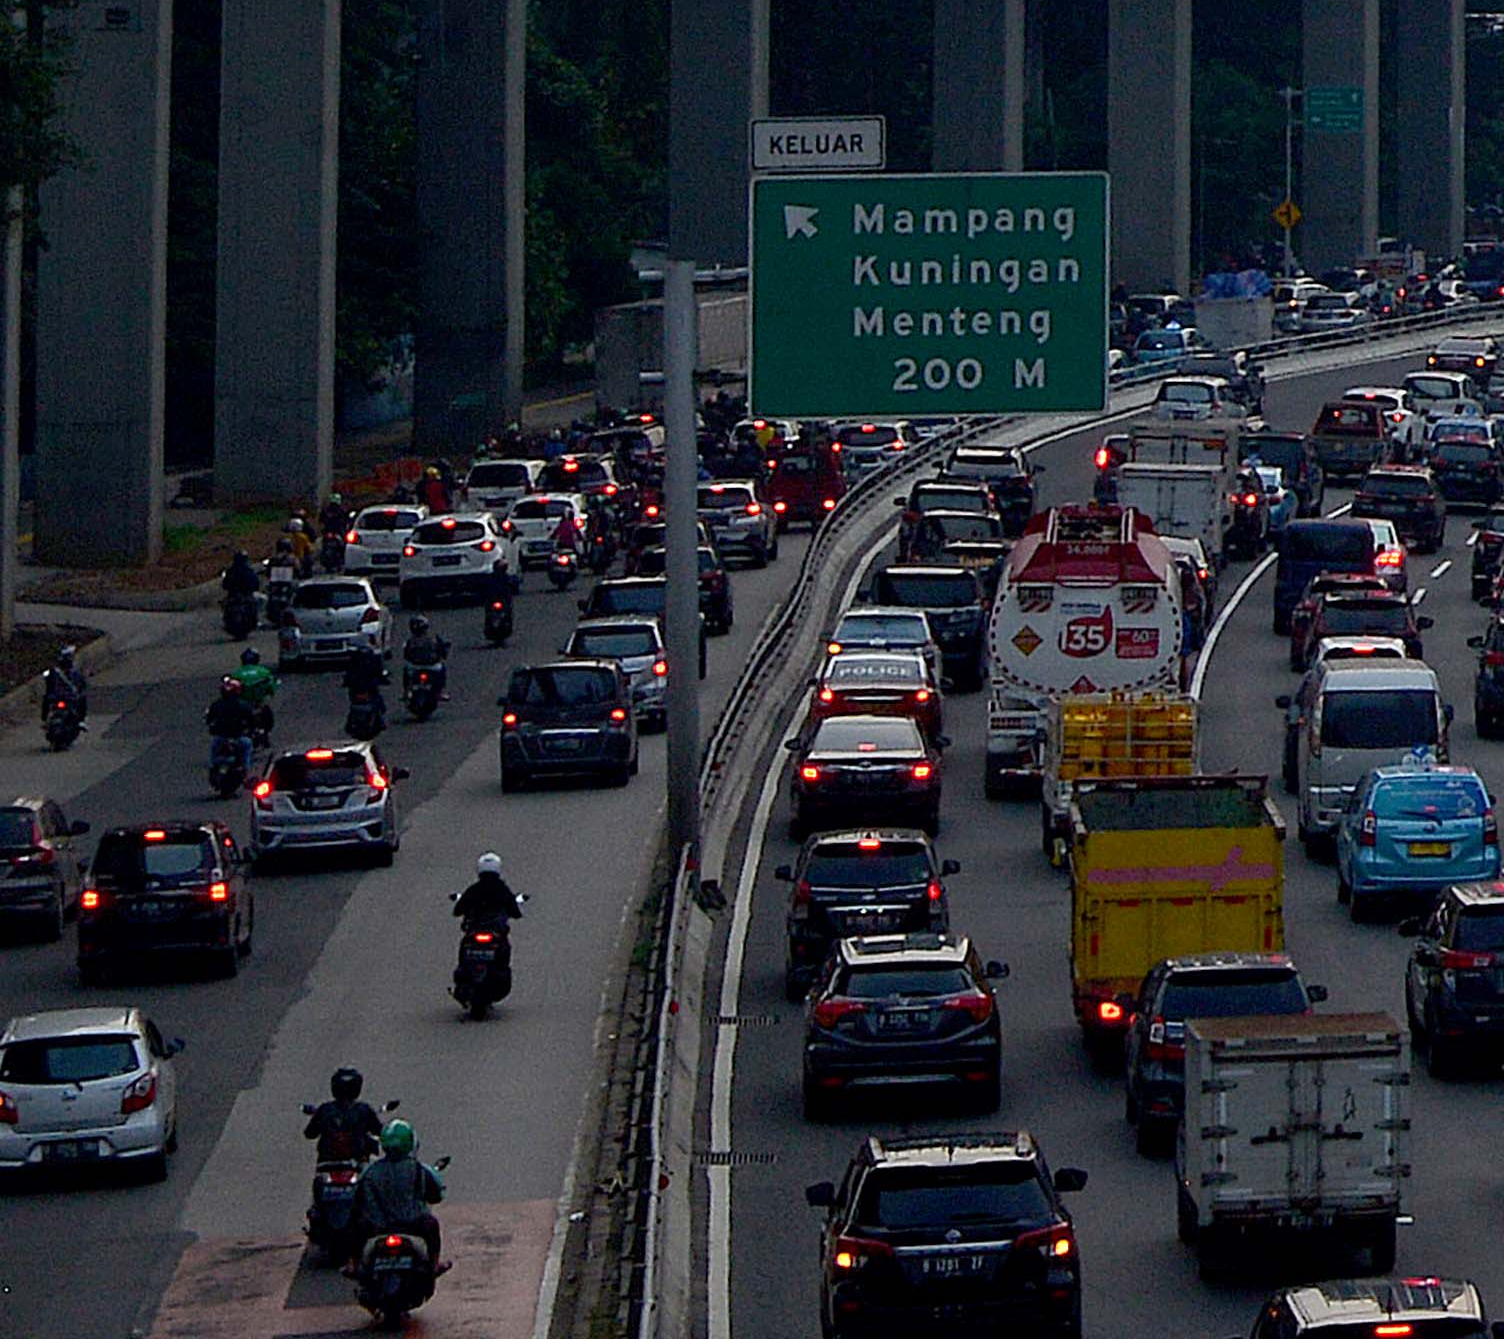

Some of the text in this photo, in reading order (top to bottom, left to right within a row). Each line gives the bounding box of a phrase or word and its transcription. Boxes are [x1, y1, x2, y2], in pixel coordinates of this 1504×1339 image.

[769, 134, 864, 155] KELUAR
[853, 204, 1076, 241] Mampang
[853, 254, 1080, 292] Kuningan
[853, 306, 1052, 343] Menteng
[893, 358, 1046, 391] 200 M
[1061, 624, 1105, 651] 135
[839, 665, 912, 677] POLICE
